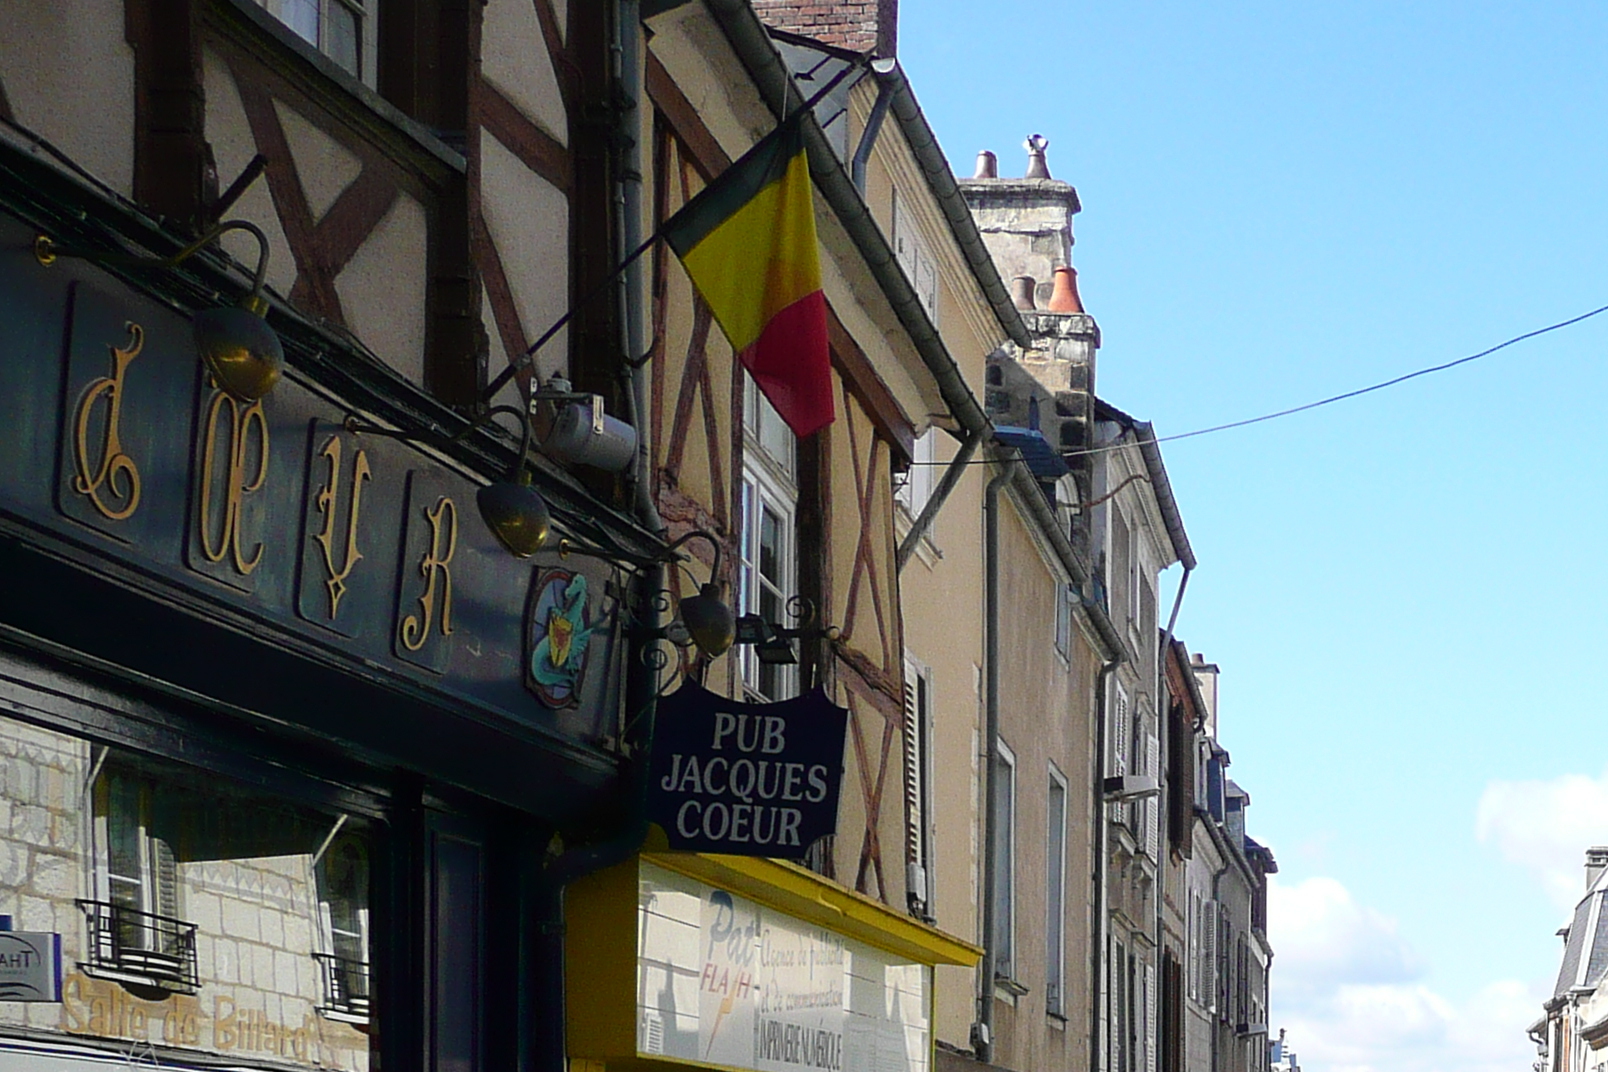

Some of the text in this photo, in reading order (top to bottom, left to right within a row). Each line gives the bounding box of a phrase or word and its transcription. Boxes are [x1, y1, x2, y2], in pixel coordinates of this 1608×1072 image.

[712, 712, 786, 755] PUB
[661, 755, 828, 804] JACQUES
[676, 801, 802, 847] COEUR
[60, 975, 314, 1062] Salle de Billard
